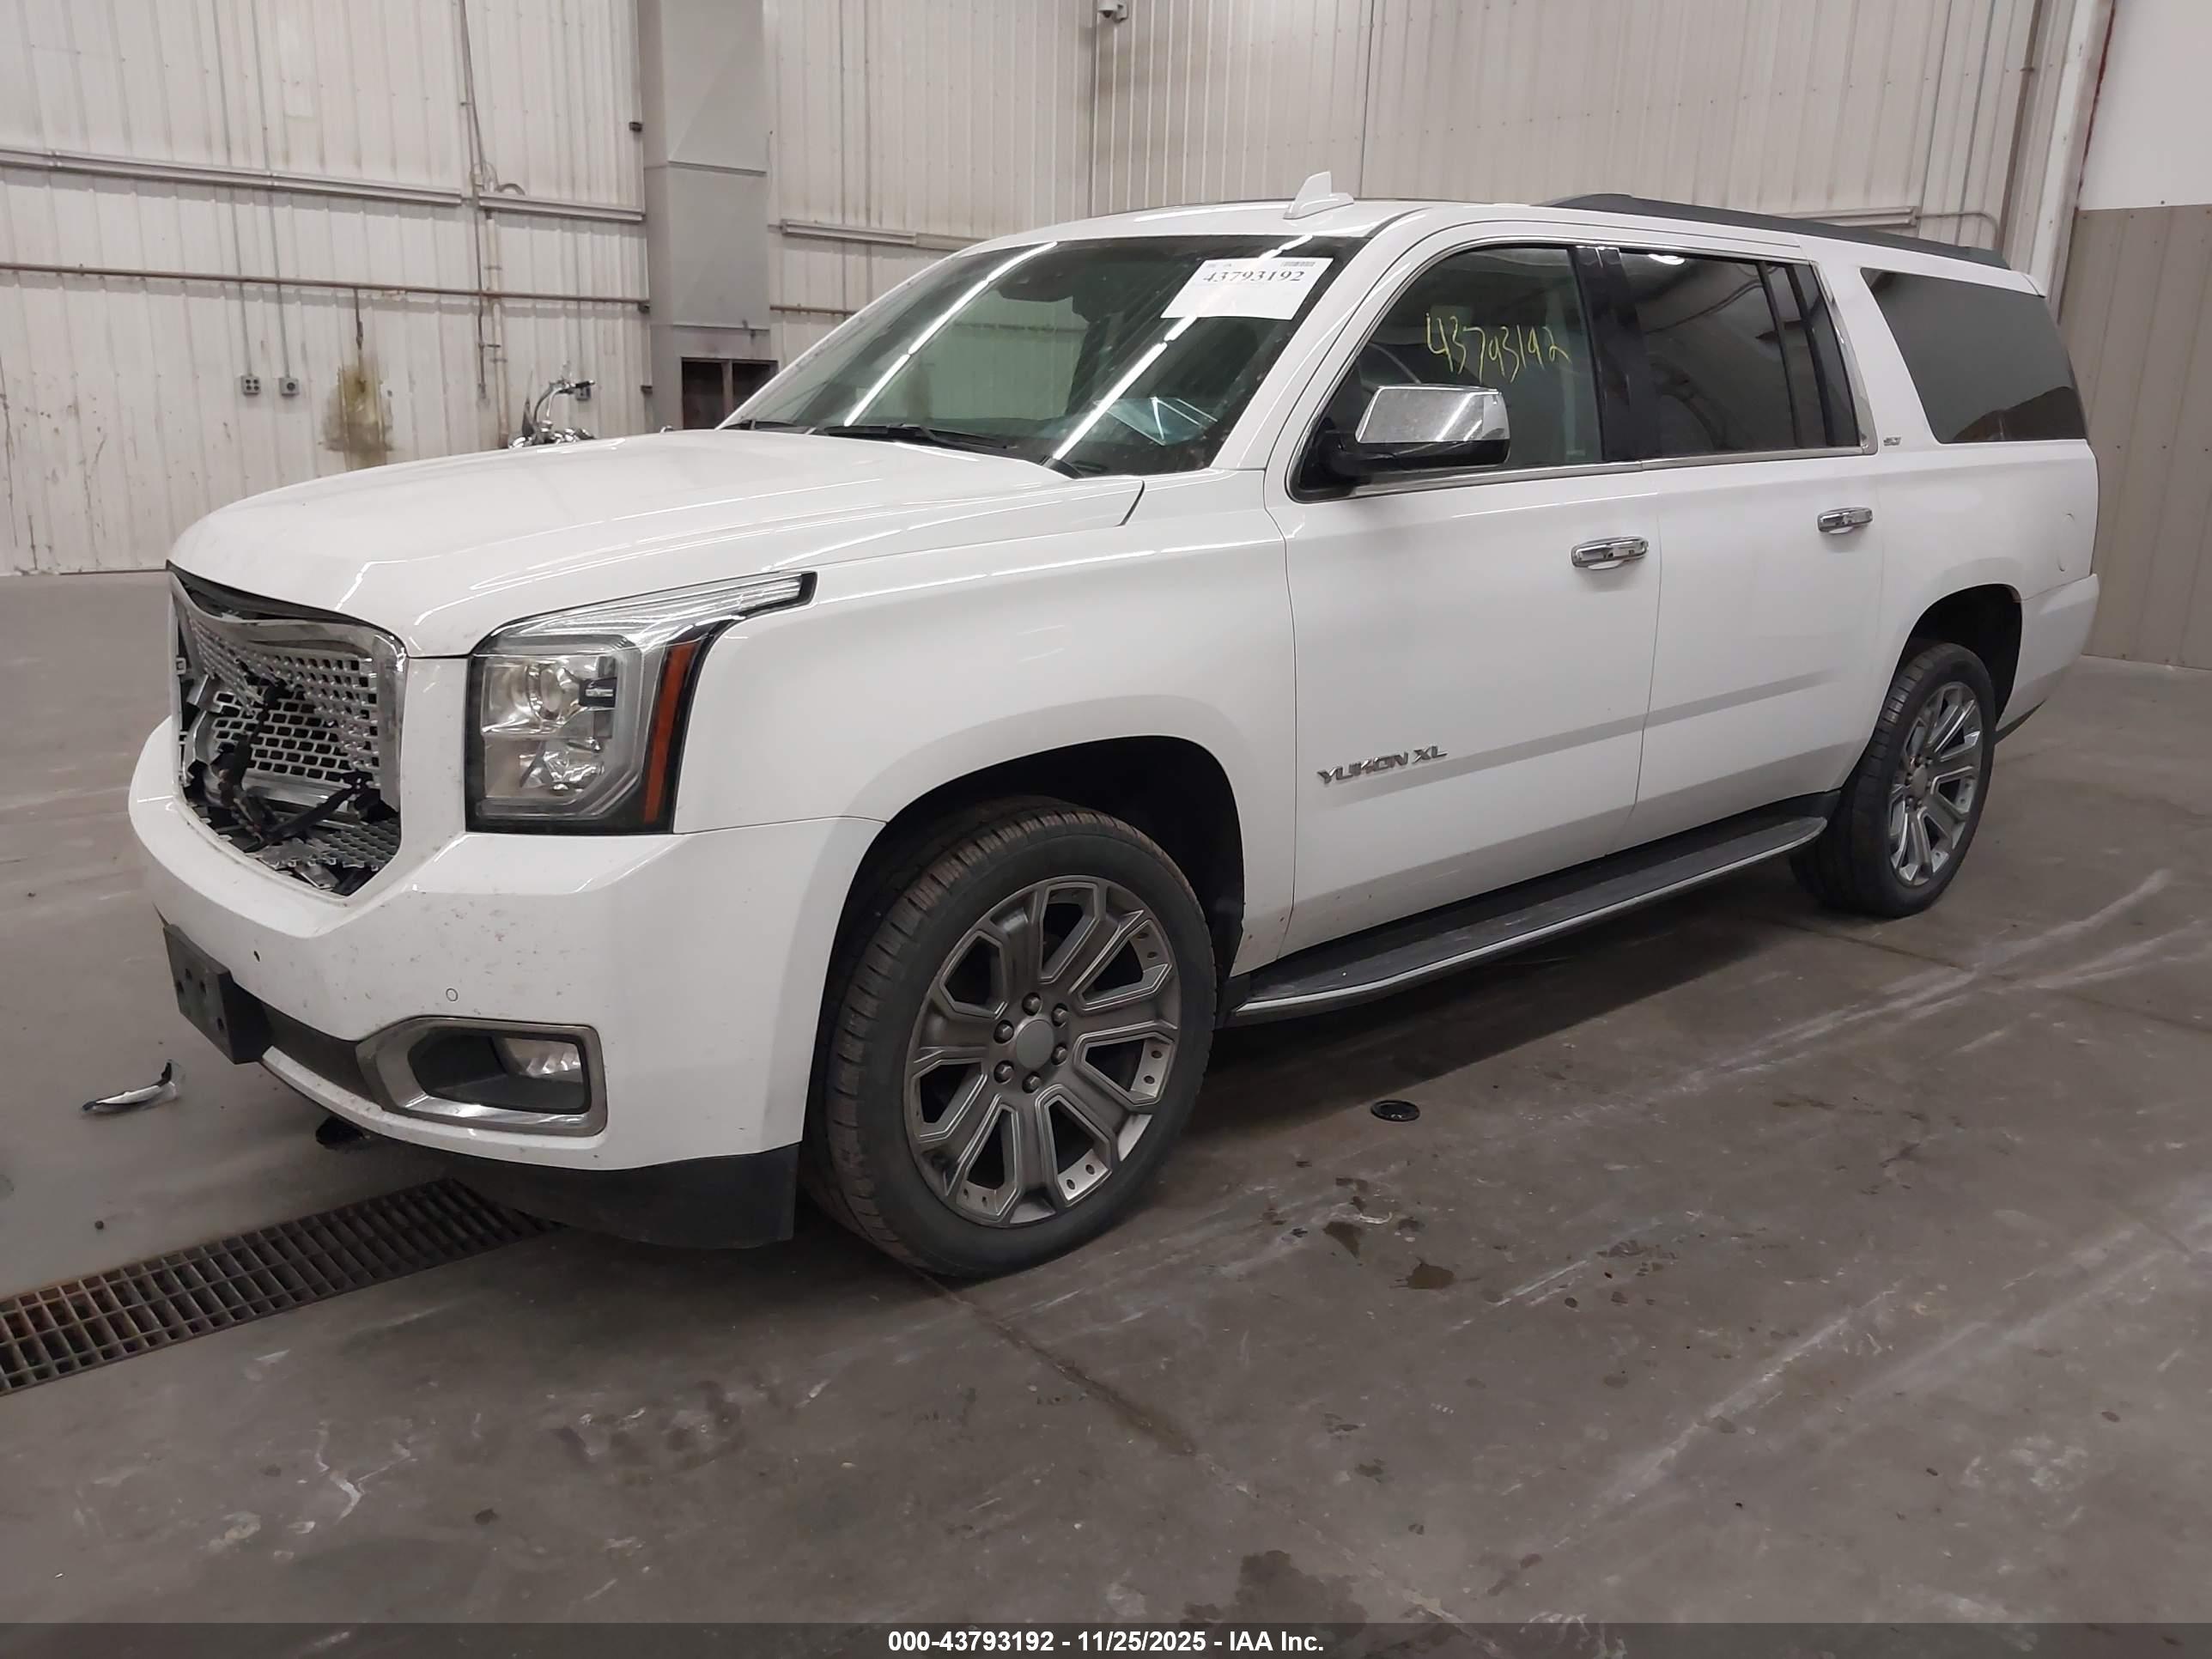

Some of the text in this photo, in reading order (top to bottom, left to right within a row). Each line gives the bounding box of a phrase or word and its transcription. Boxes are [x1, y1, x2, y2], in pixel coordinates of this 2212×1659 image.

[1203, 270, 1305, 283] 43793192
[1426, 313, 1571, 383] 43793192
[1317, 745, 1449, 784] YUKON XL
